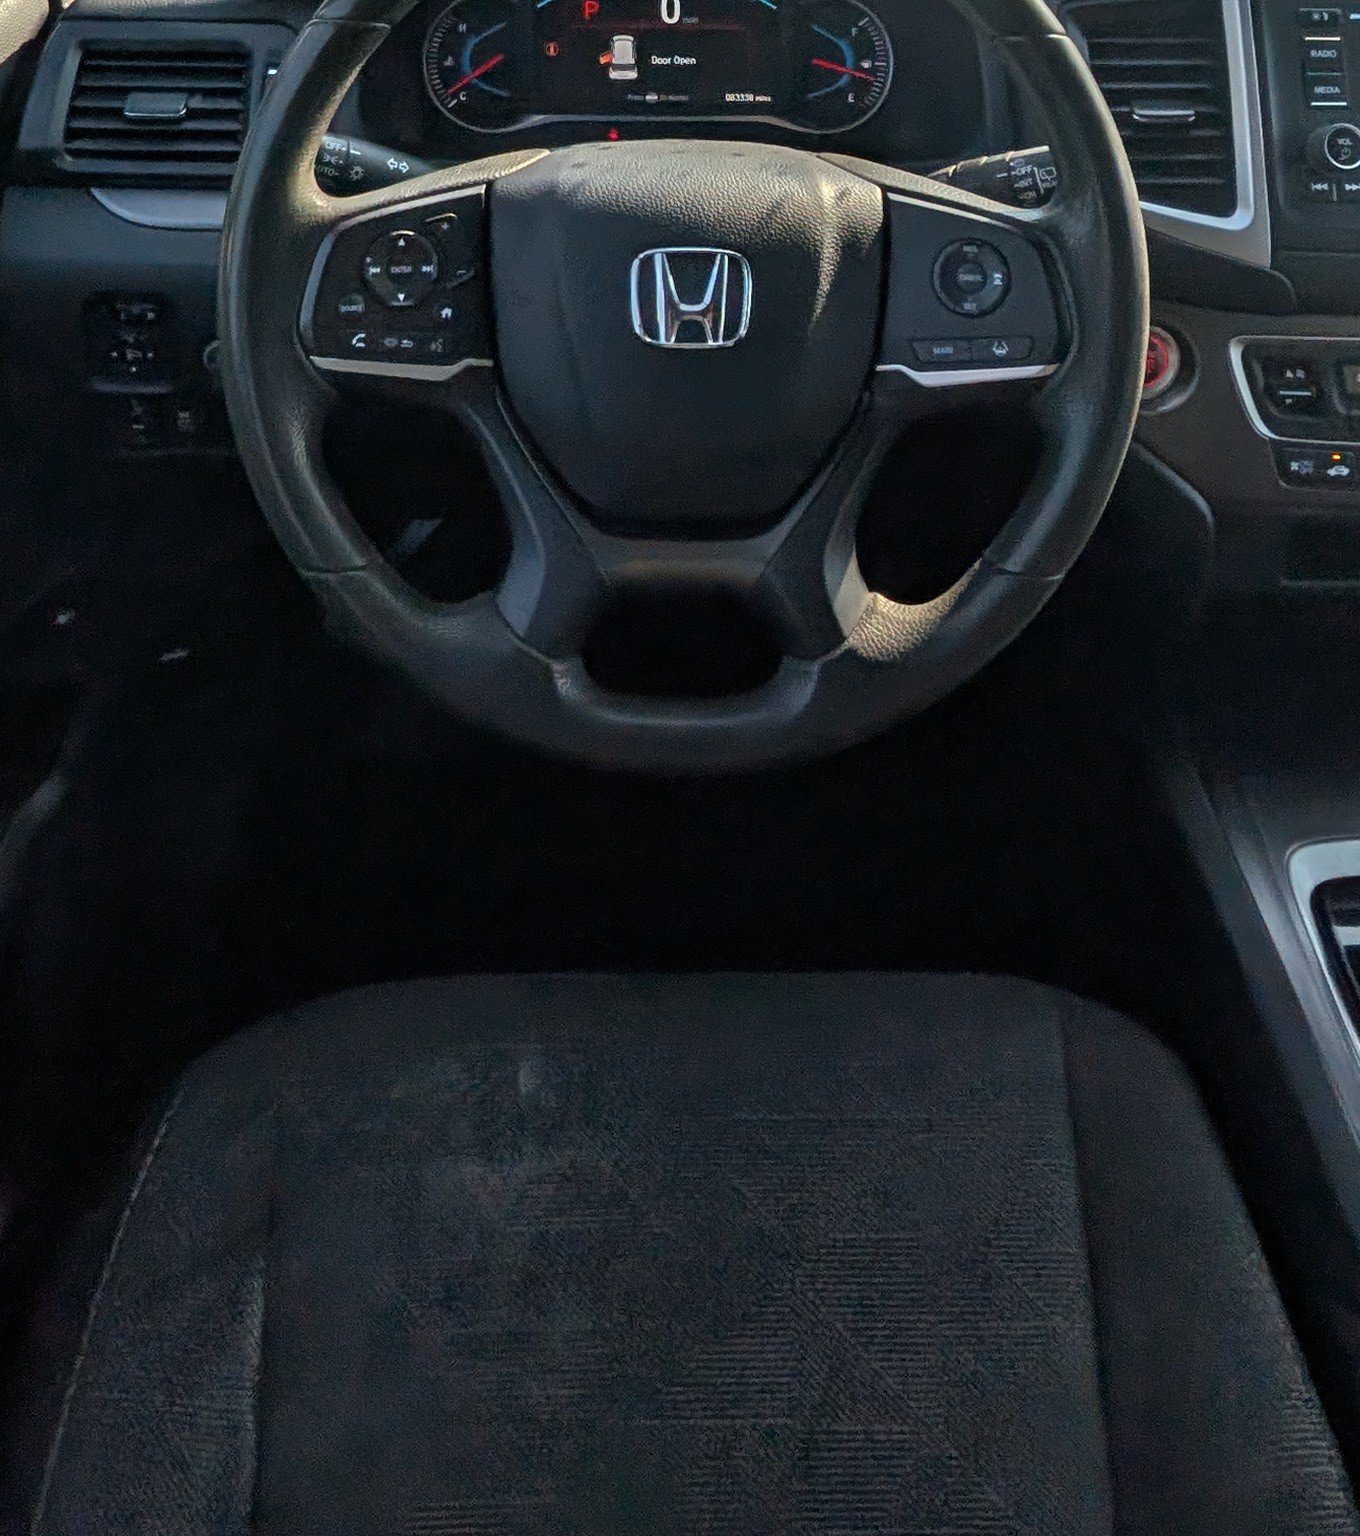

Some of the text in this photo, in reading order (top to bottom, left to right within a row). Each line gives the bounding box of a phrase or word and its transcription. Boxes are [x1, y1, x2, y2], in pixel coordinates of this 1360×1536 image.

[581, 0, 601, 21] P
[1310, 49, 1338, 58] RADIO
[651, 55, 697, 65] Door Open
[1314, 85, 1341, 94] MEDIA
